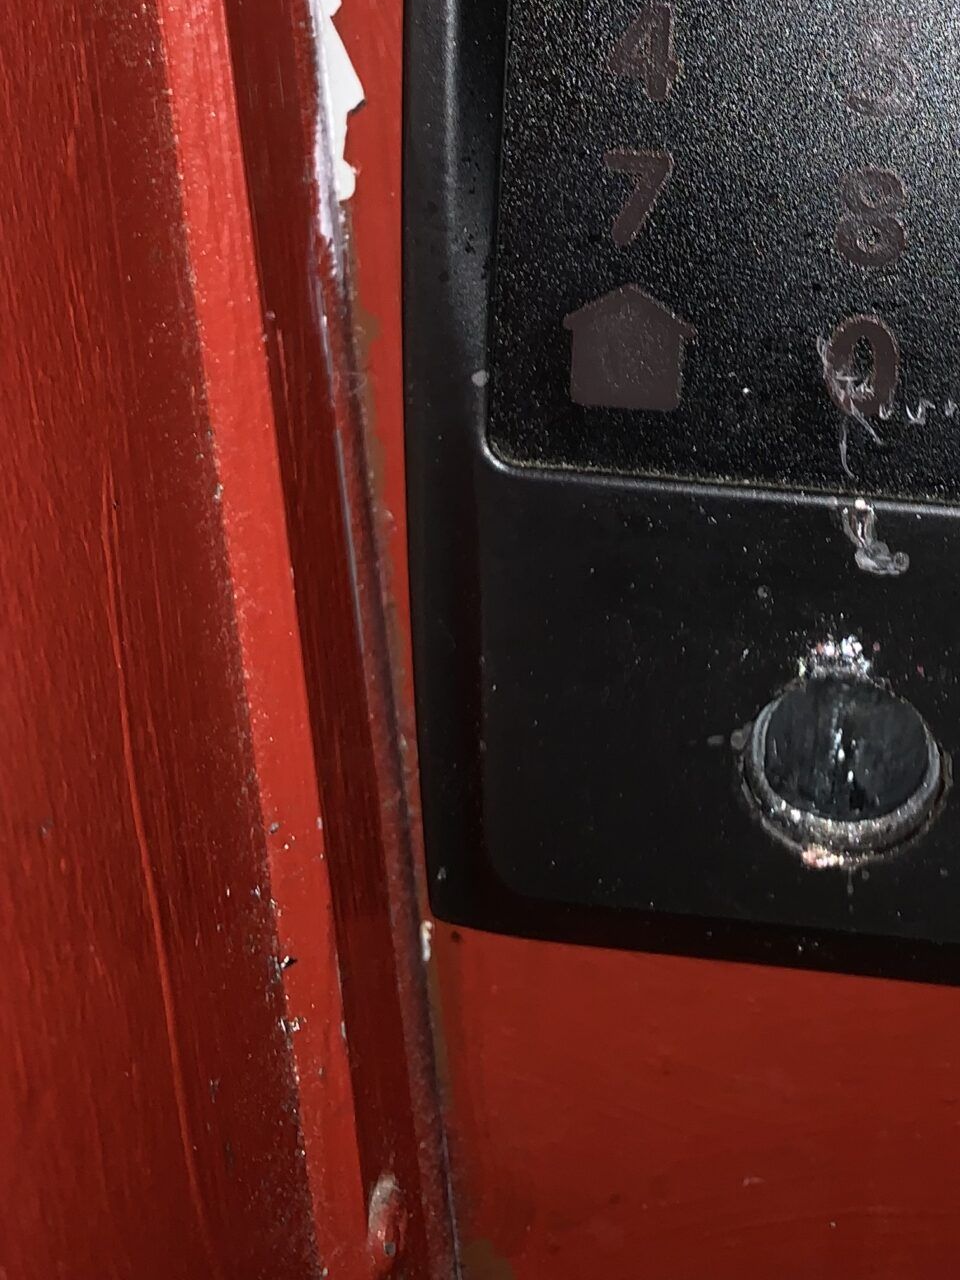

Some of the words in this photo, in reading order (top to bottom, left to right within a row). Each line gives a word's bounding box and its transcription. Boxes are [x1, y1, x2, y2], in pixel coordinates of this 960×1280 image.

[607, 2, 681, 102] 4
[846, 18, 917, 119] 5
[604, 149, 675, 247] 7
[835, 164, 908, 267] 8
[826, 313, 901, 417] 0
